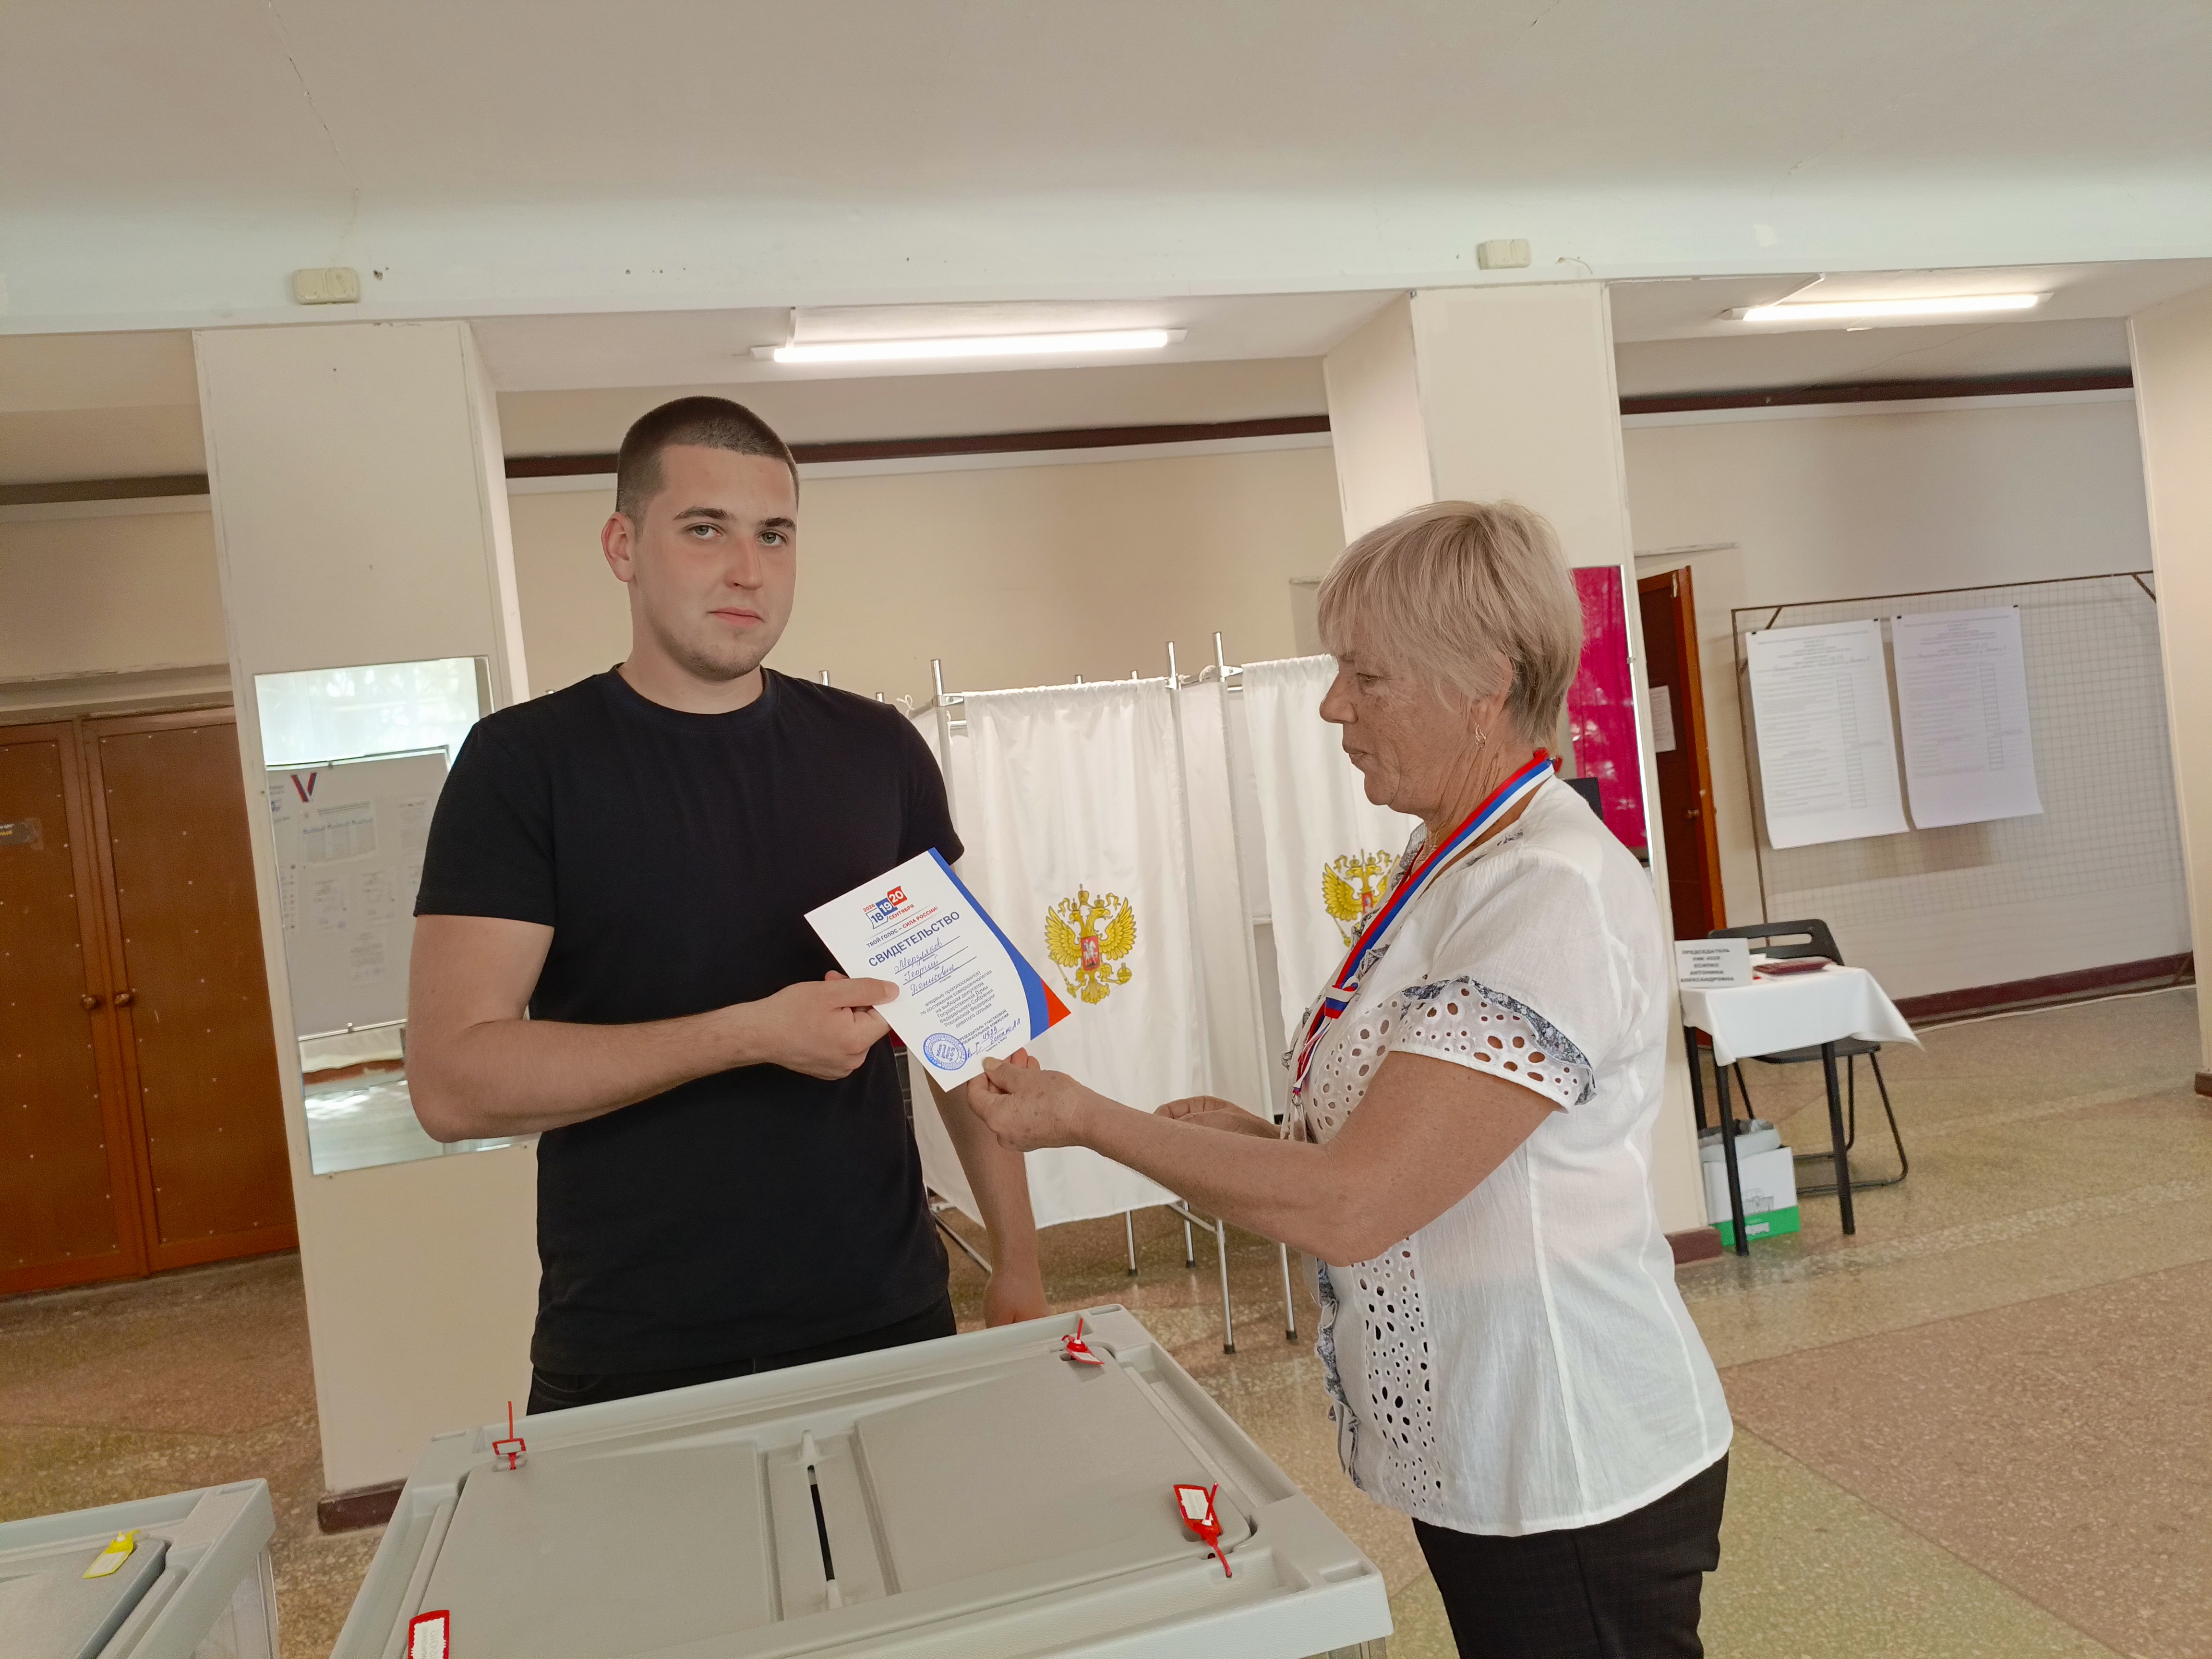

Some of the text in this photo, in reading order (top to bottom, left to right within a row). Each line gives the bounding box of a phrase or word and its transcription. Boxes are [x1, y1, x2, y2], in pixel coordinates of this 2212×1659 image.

[863, 903, 876, 912] 2026
[871, 890, 904, 923] 18 19 20
[889, 904, 914, 920] СЕНТЯБРЯ
[866, 937, 881, 948] ТВОЙ
[880, 928, 898, 940] ГОЛОС
[902, 919, 917, 928] СИЛА
[916, 906, 938, 920] РОССИИ!
[869, 912, 959, 966] СВИДЕТЕЛЬСТВО
[925, 971, 981, 1007] впервые проголосовал(а)
[926, 995, 953, 1013] достижении
[953, 970, 992, 996] совершеннолетия
[937, 986, 988, 1018] Государственной Думы
[941, 996, 961, 1010] выборах
[962, 982, 984, 998] депутатов
[939, 988, 994, 1023] Федерального Собрания
[944, 994, 996, 1027] Российской Федерации
[956, 1014, 975, 1028] девятого
[984, 1010, 1007, 1026] УЧАСТКОВОЙ
[990, 1013, 1009, 1027] КОМИССИИ
